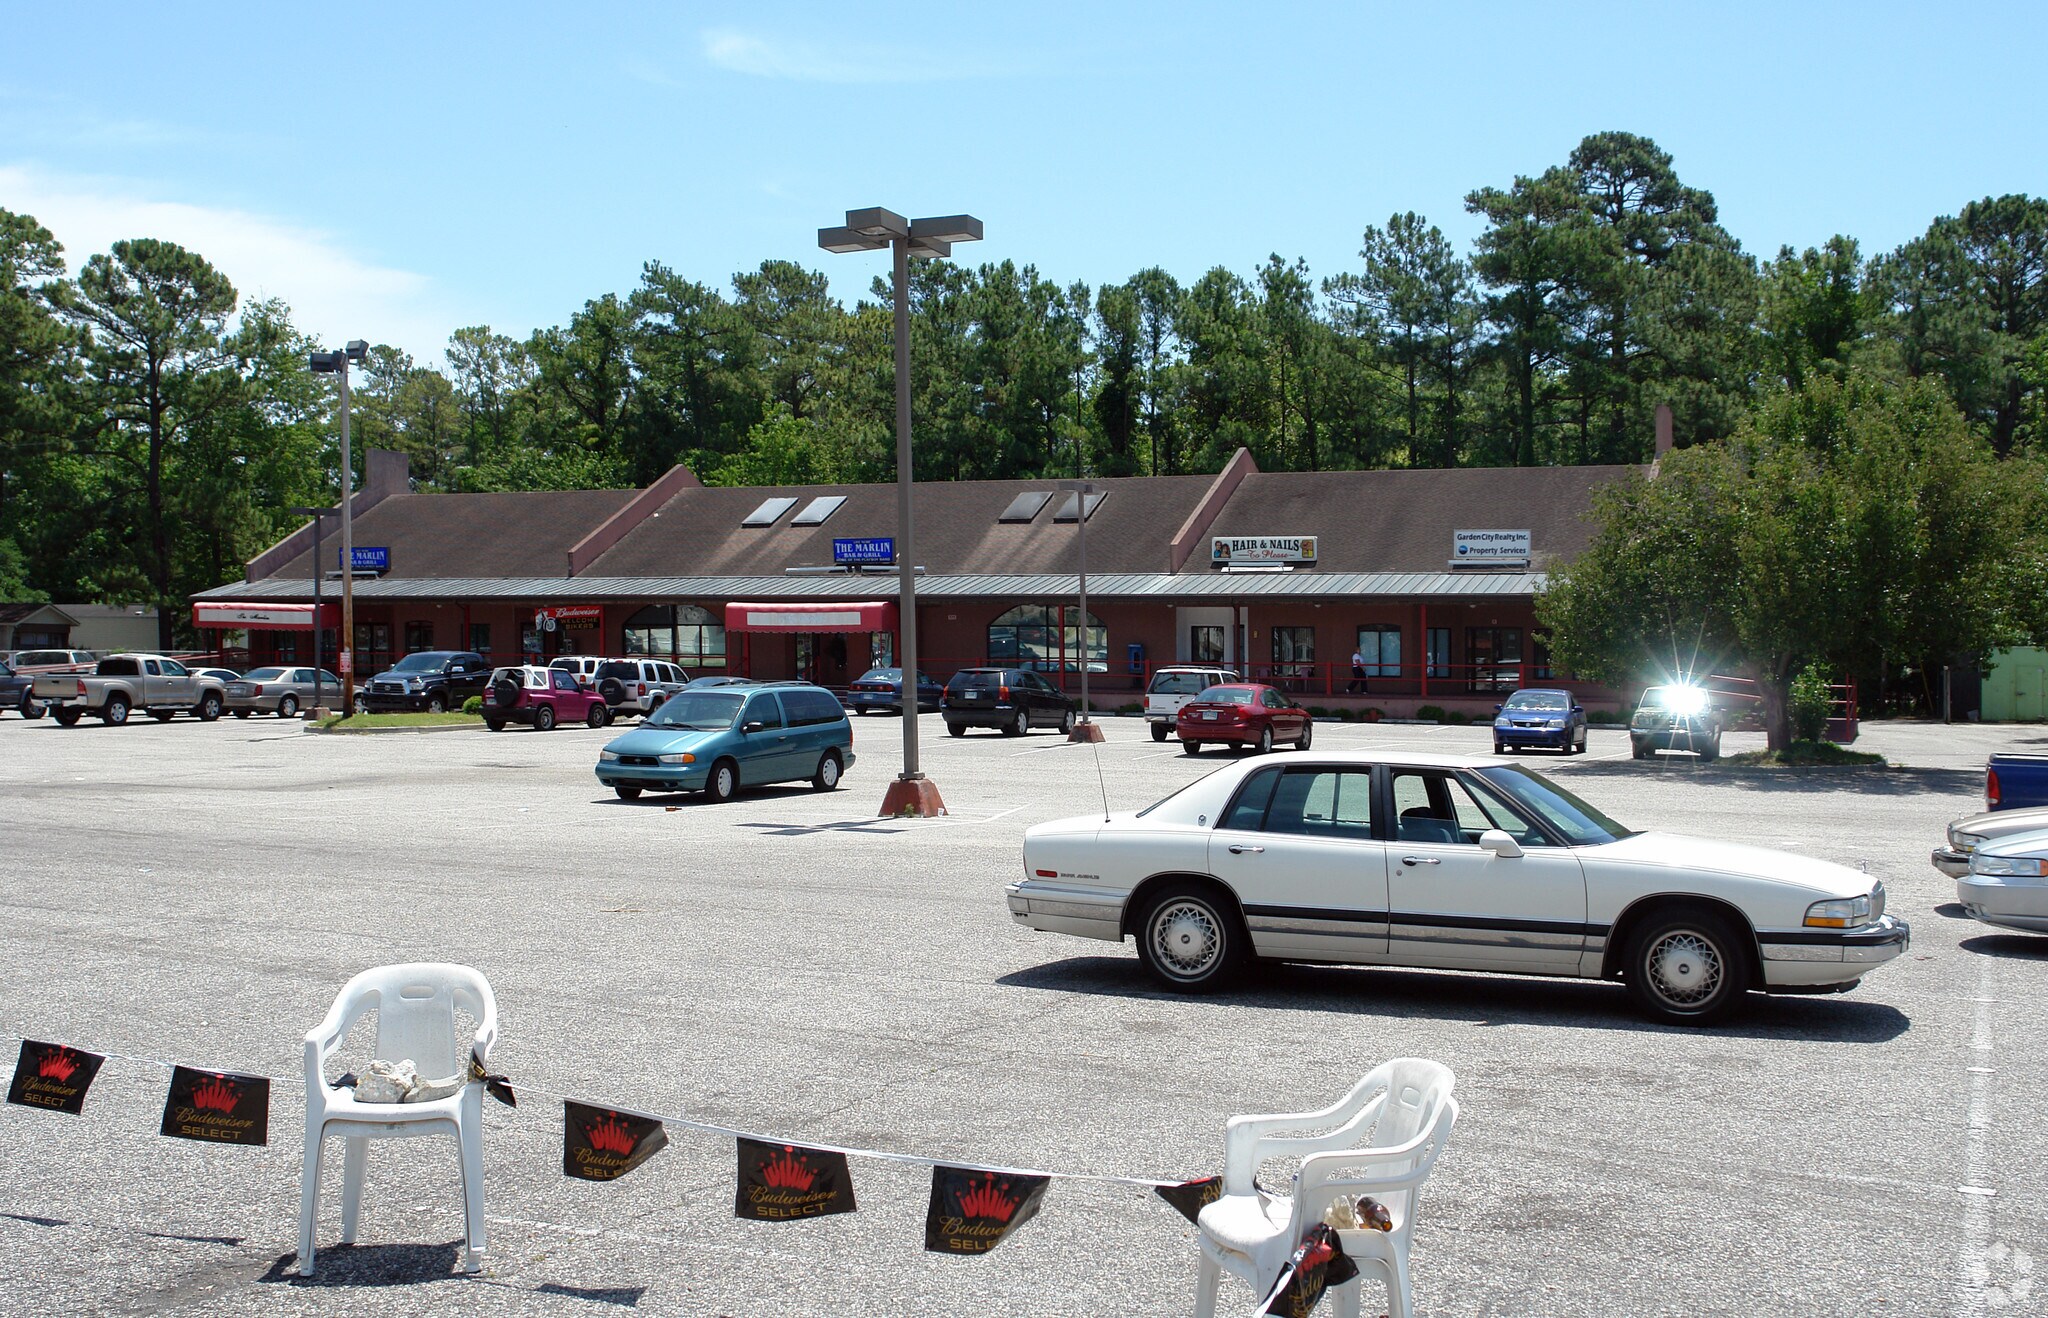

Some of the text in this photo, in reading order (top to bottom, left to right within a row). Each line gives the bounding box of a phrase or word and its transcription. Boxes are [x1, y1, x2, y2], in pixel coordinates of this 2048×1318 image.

[1481, 533, 1495, 542] City
[835, 542, 890, 553] THE MARLIN
[1232, 539, 1300, 552] HAIR & NAILS
[1469, 547, 1499, 555] Property
[356, 550, 385, 560] MARLIN
[1247, 549, 1288, 559] To Please
[555, 607, 600, 618] Budweiser
[21, 1074, 78, 1096] Budweiser
[23, 1092, 66, 1107] SELECT
[174, 1106, 255, 1128] Budweiser
[181, 1125, 242, 1139] SELECT
[747, 1184, 838, 1205] Budweiser
[756, 1202, 828, 1217] SELECT
[940, 1215, 1009, 1237] Budwe
[949, 1238, 997, 1250] SELE
